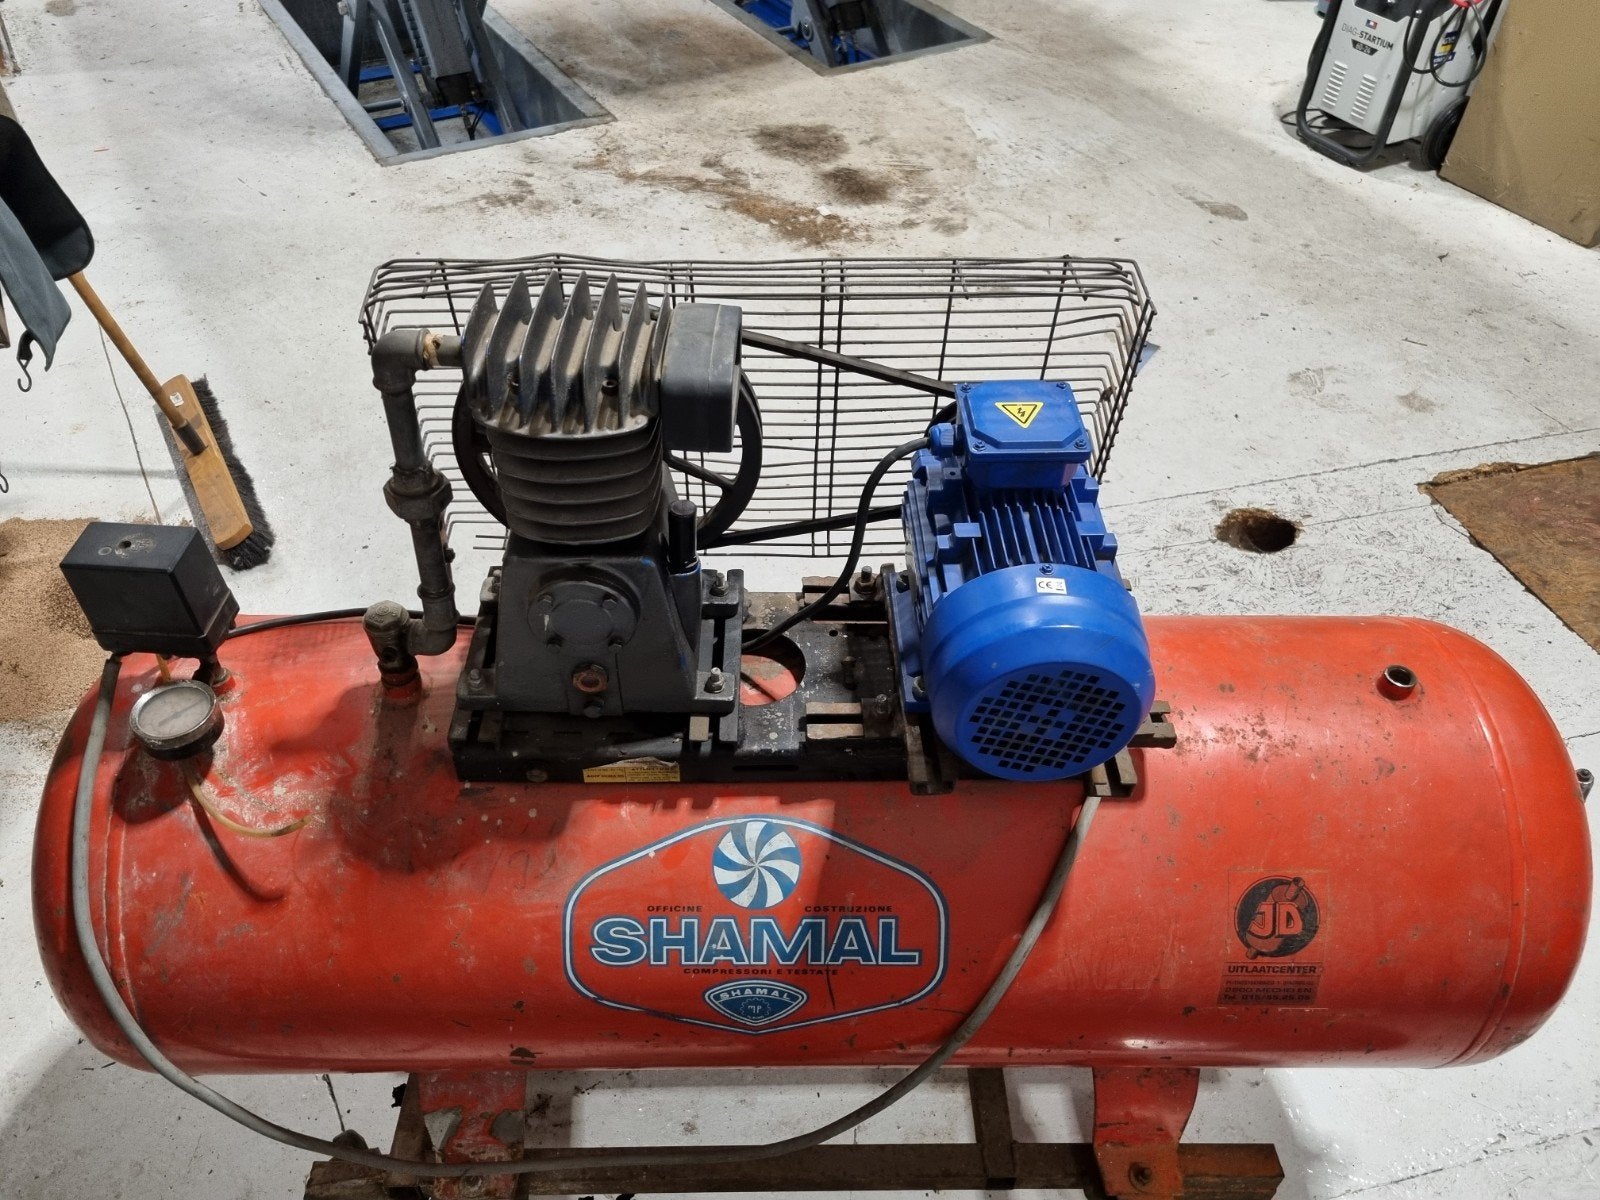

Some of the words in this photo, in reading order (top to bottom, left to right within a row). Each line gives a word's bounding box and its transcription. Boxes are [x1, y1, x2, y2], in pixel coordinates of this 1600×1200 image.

[804, 905, 893, 913] COSTRUZIONE
[1247, 901, 1303, 939] JD
[591, 916, 920, 967] SHAMAL
[786, 968, 839, 976] TESTATE
[1227, 965, 1317, 974] UITLAATCENTER
[719, 987, 791, 1001] SHAMAL
